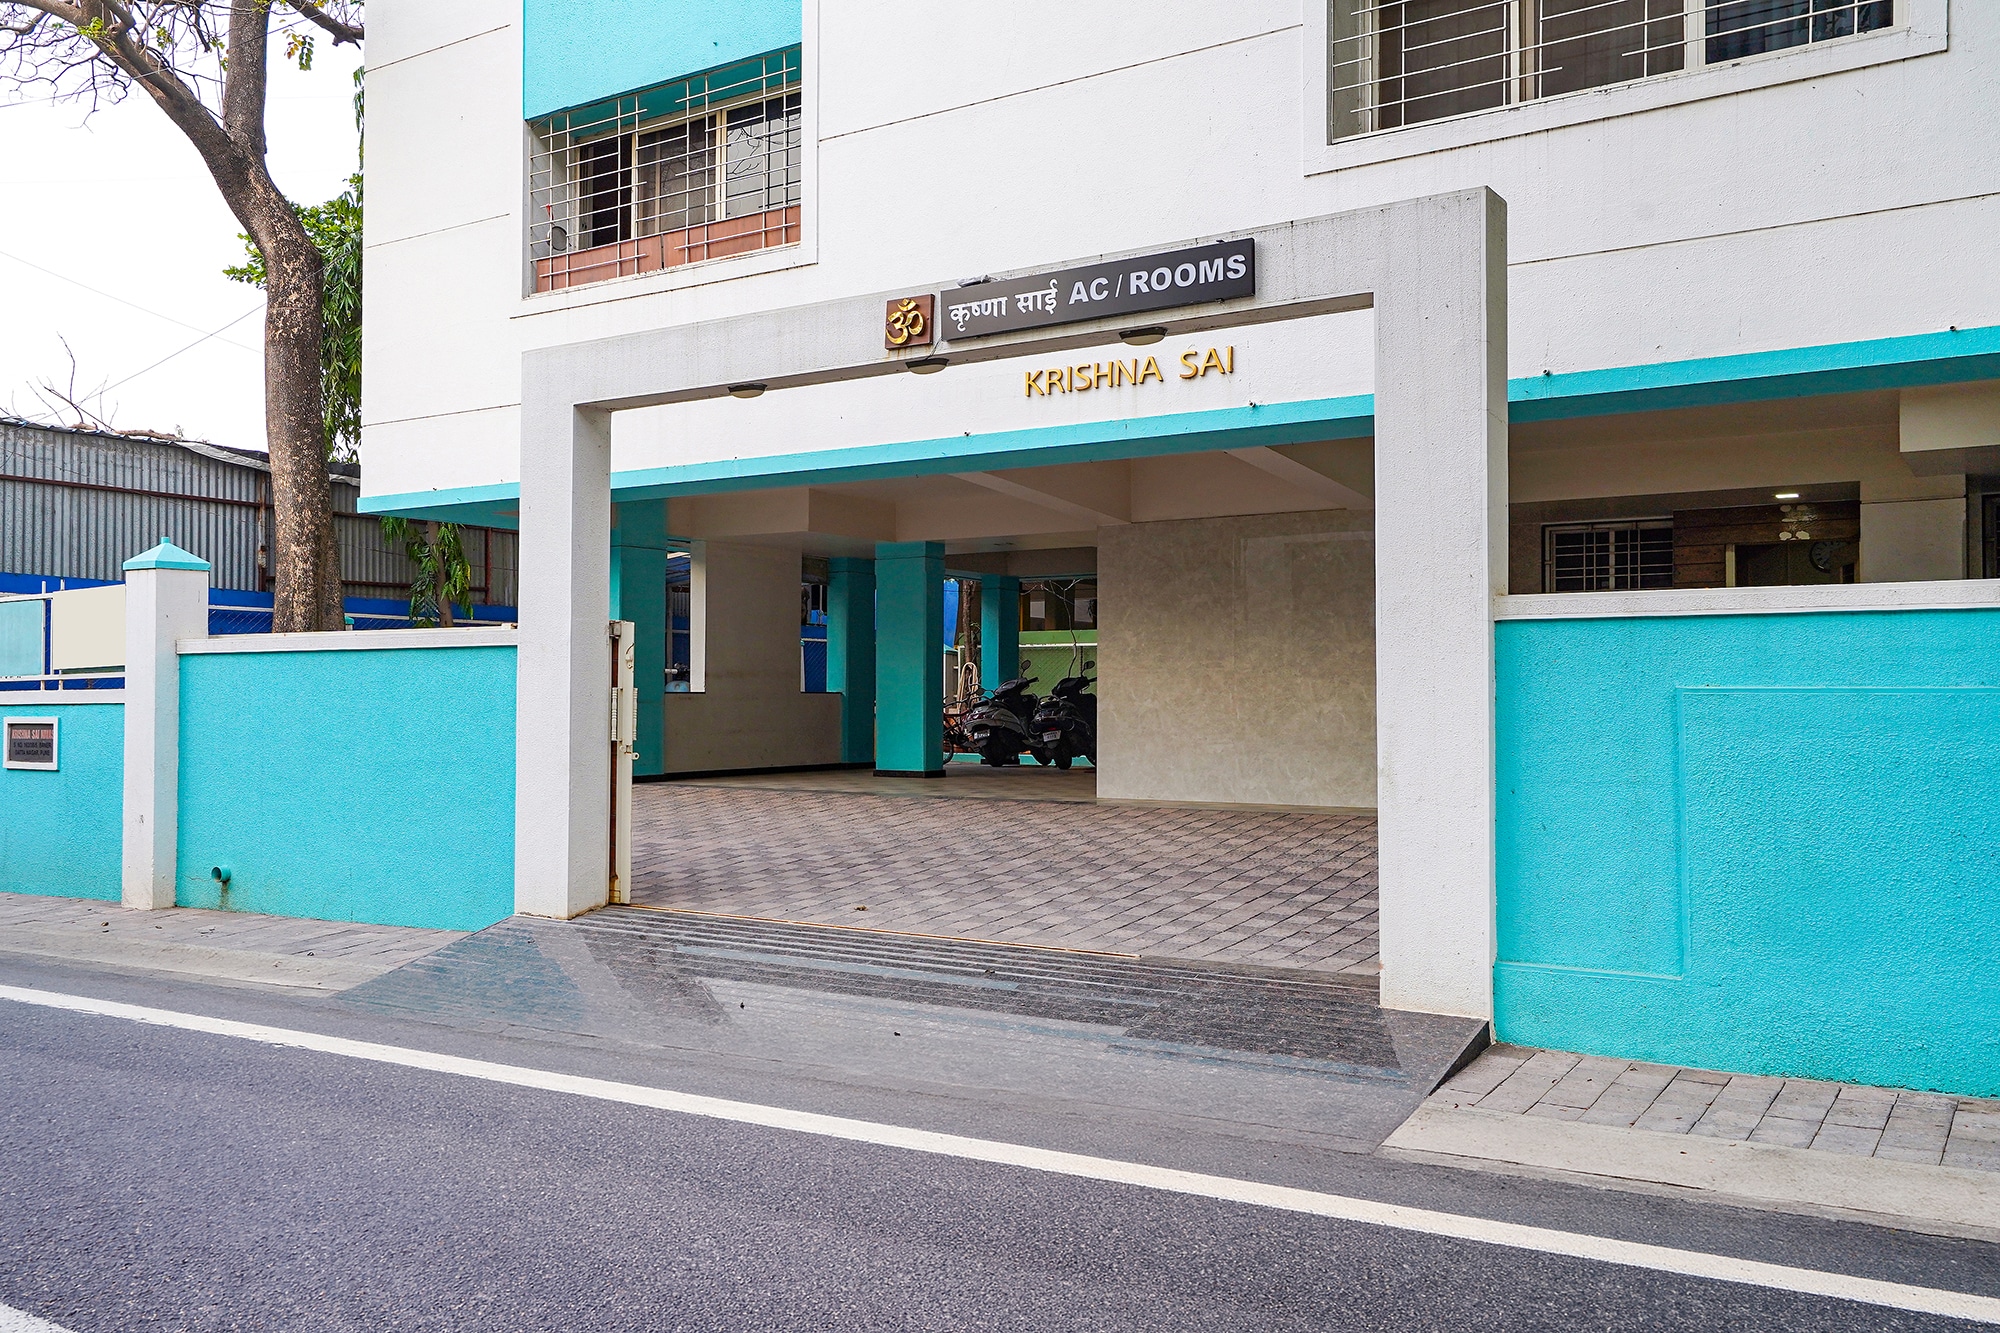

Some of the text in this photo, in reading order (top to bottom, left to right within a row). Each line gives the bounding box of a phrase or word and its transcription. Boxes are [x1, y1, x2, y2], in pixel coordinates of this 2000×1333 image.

[948, 296, 1008, 332] कृष्णा
[1015, 278, 1058, 315] साई
[1068, 277, 1109, 305] AC
[1129, 254, 1247, 295] ROOMS
[1024, 345, 1235, 398] KRISHNA SAI
